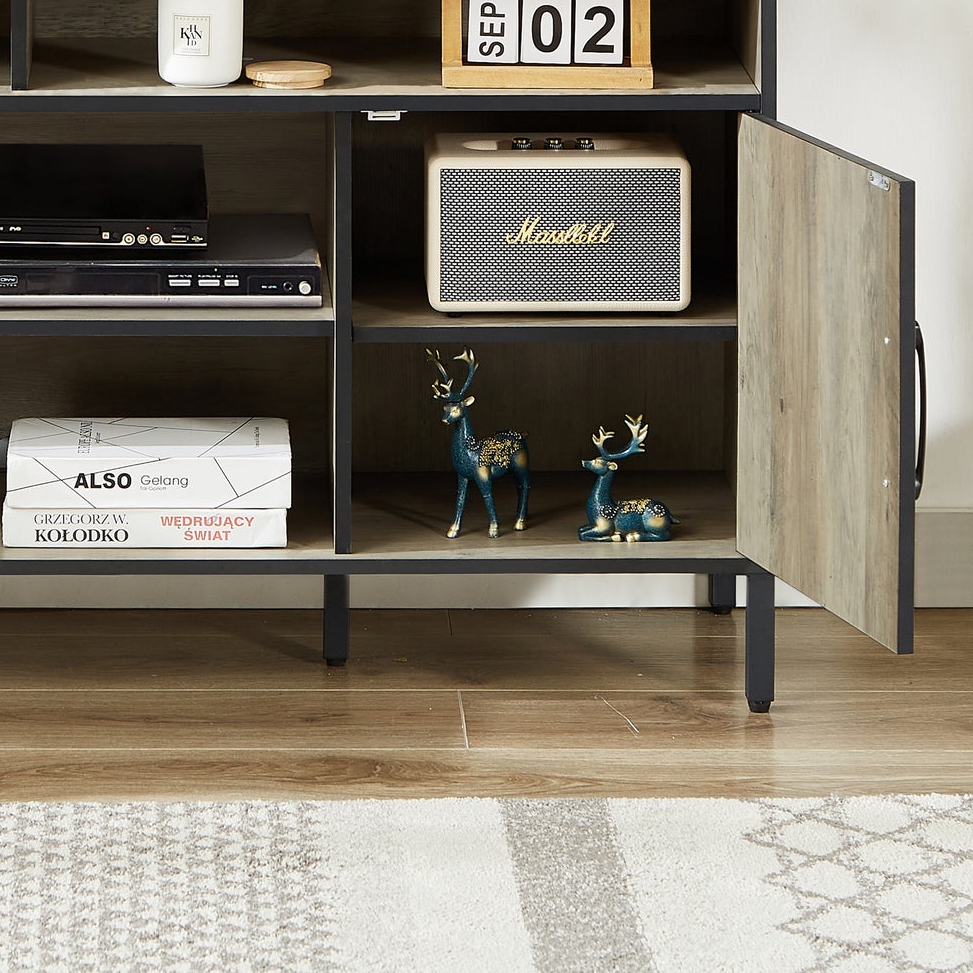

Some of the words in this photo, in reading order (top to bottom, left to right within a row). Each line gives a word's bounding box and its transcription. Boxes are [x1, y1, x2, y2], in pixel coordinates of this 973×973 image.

[479, 2, 505, 57] SEP
[74, 472, 133, 489] ALSO
[140, 474, 189, 488] Gelang
[33, 513, 110, 525] GRZEGORZ
[112, 513, 129, 525] W.
[160, 515, 255, 529] WĘDRUJĄCY
[34, 528, 130, 543] KOŁODKO
[183, 527, 231, 541] ŚWIAT
